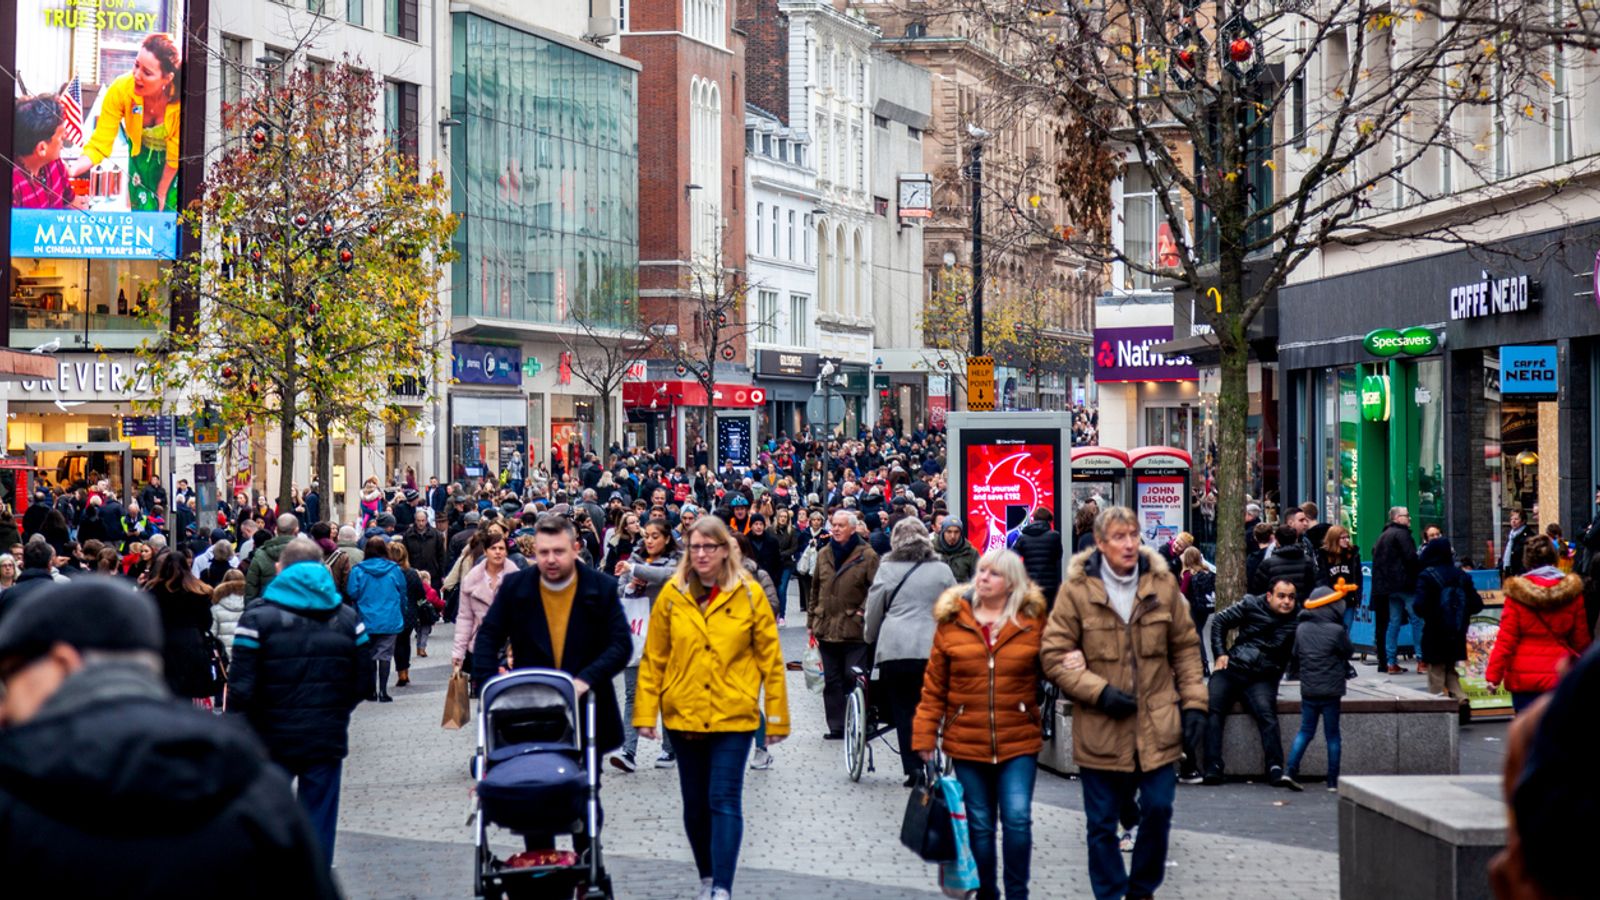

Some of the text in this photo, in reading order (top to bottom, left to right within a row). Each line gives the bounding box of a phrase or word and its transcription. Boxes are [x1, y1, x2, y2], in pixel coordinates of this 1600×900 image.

[104, 0, 124, 8] ON
[128, 0, 136, 8] A
[43, 9, 157, 31] TRUE STORY
[56, 215, 134, 224] WELCOME TO
[34, 223, 154, 246] MARWEN
[33, 245, 153, 256] IN CINEMAS NEW YEAR'S DAY
[1491, 275, 1528, 315] NERO
[1372, 335, 1432, 349] Specsavers
[8, 362, 123, 391] EVER
[971, 369, 990, 377] HELP
[1505, 369, 1555, 381] NERO
[970, 380, 992, 388] POINT
[973, 485, 1020, 493] Spoil yourself
[1147, 486, 1175, 494] JOHN
[1141, 495, 1180, 503] BISHOP
